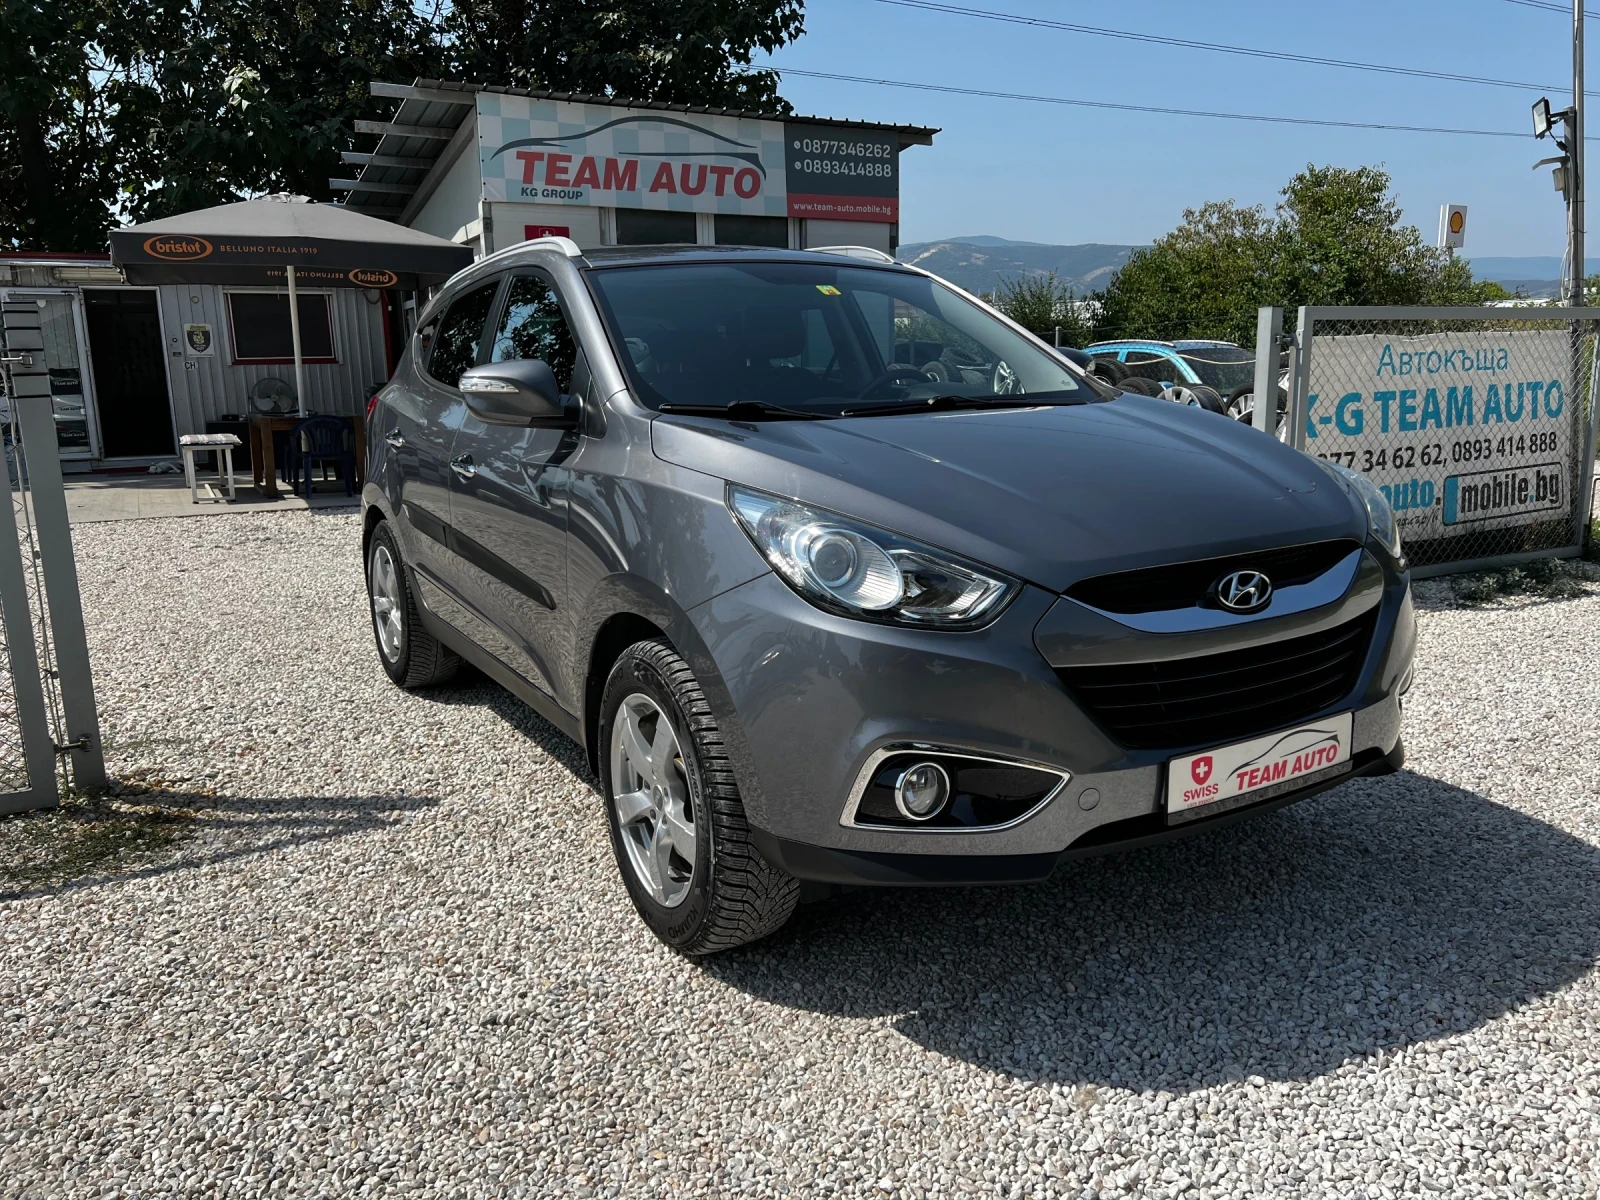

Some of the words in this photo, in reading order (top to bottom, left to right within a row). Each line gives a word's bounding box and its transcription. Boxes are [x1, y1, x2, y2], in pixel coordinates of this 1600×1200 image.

[803, 139, 891, 158] 0877346262
[515, 150, 638, 192] TEAM
[648, 161, 762, 200] AUTO
[804, 159, 892, 177] 0893414888
[520, 187, 539, 199] KG
[541, 187, 584, 200] GROUP
[793, 203, 892, 216] www.team-auto.mobile.bg
[155, 239, 201, 254] bristot
[220, 245, 264, 253] BELLUNO
[267, 246, 298, 254] ITALIA
[300, 247, 318, 255] 1919
[184, 361, 196, 370] CH
[1376, 344, 1508, 377] Автокъща
[1373, 385, 1474, 433] TEAM
[1482, 379, 1564, 425] AUTO
[1362, 449, 1388, 472] 34
[1392, 446, 1415, 469] 62
[1421, 443, 1447, 468] 62,
[1452, 438, 1492, 463] 0893
[1496, 435, 1526, 458] 414
[1529, 432, 1558, 453] 888
[1459, 470, 1560, 514] mobile.bg
[1236, 760, 1288, 791] TEAM
[1290, 744, 1338, 775] AUTO
[1183, 783, 1219, 802] SWISS
